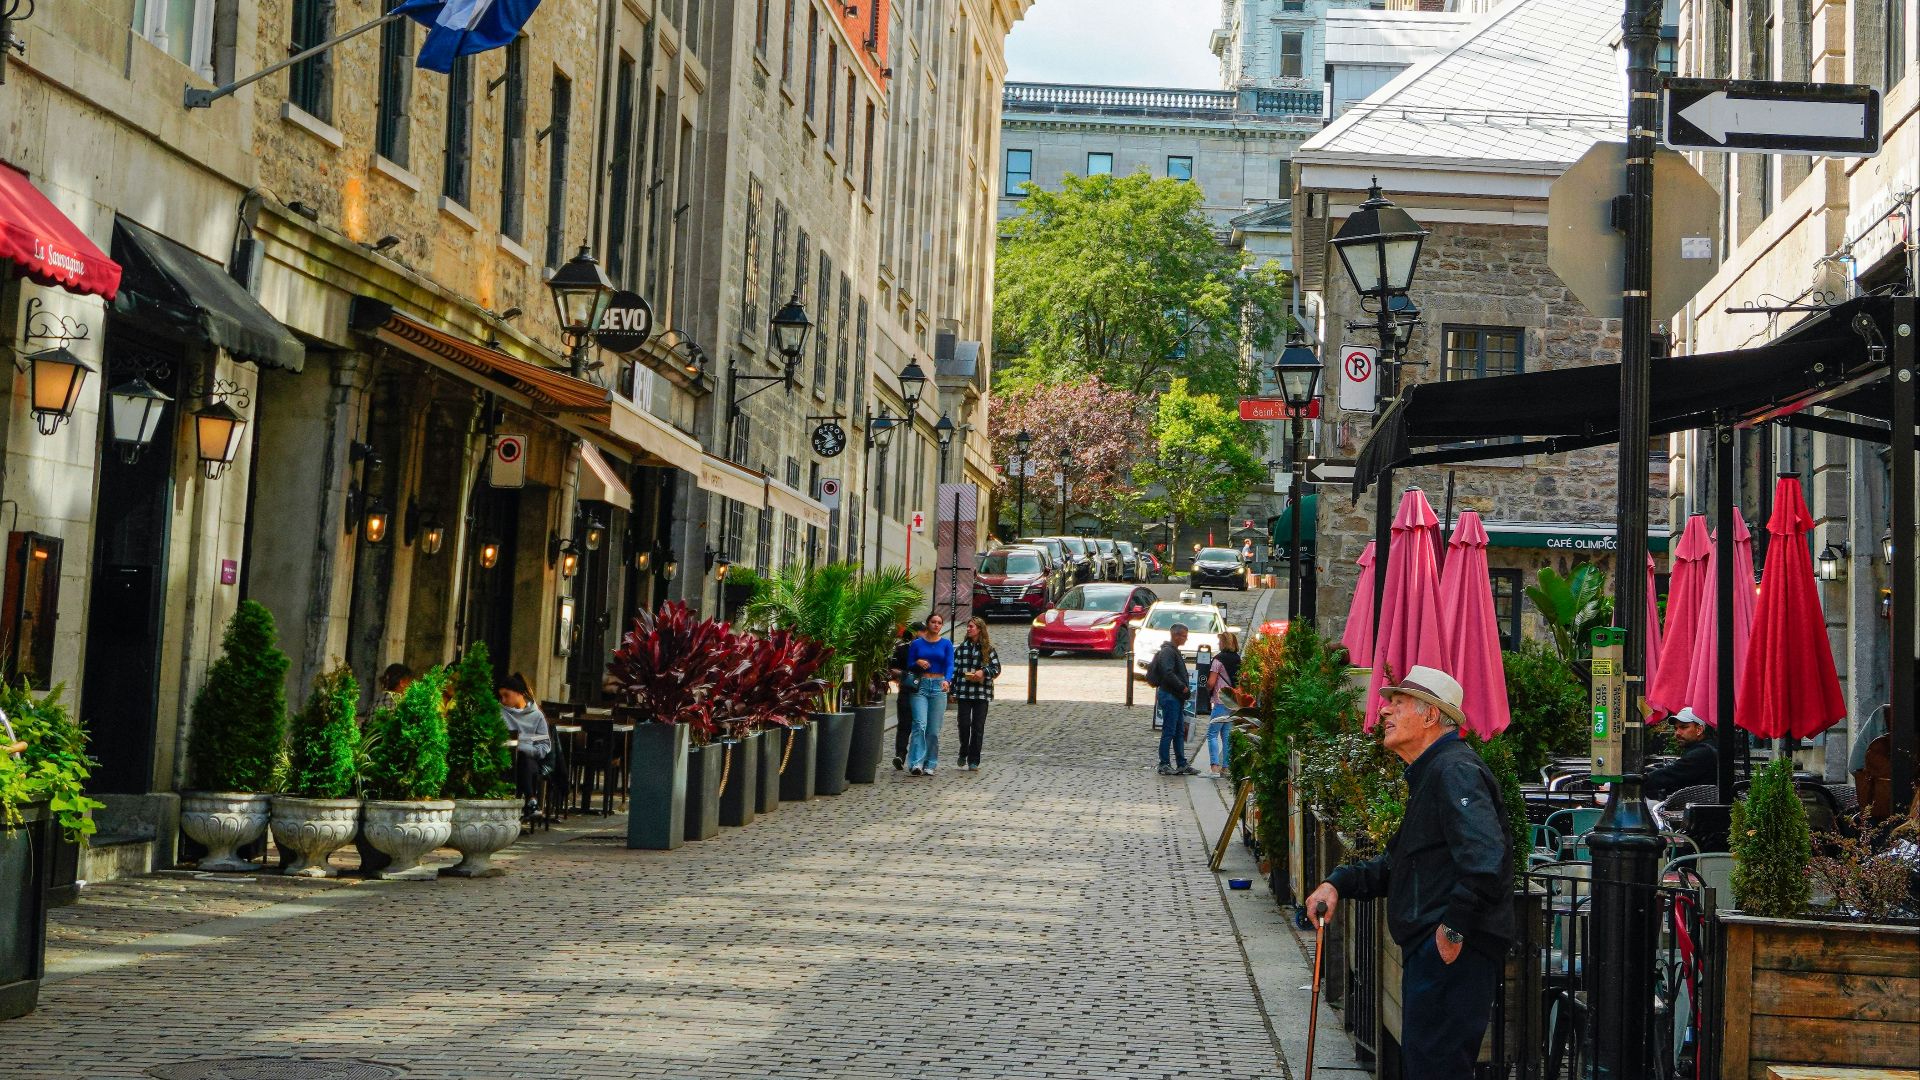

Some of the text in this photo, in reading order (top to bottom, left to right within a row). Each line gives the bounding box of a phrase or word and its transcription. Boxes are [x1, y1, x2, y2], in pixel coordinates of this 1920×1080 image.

[34, 238, 85, 279] La Sauvagine
[599, 307, 646, 331] BEVO
[818, 425, 843, 440] BISOU
[814, 440, 840, 455] BISOU
[1546, 537, 1572, 548] CAFÉ
